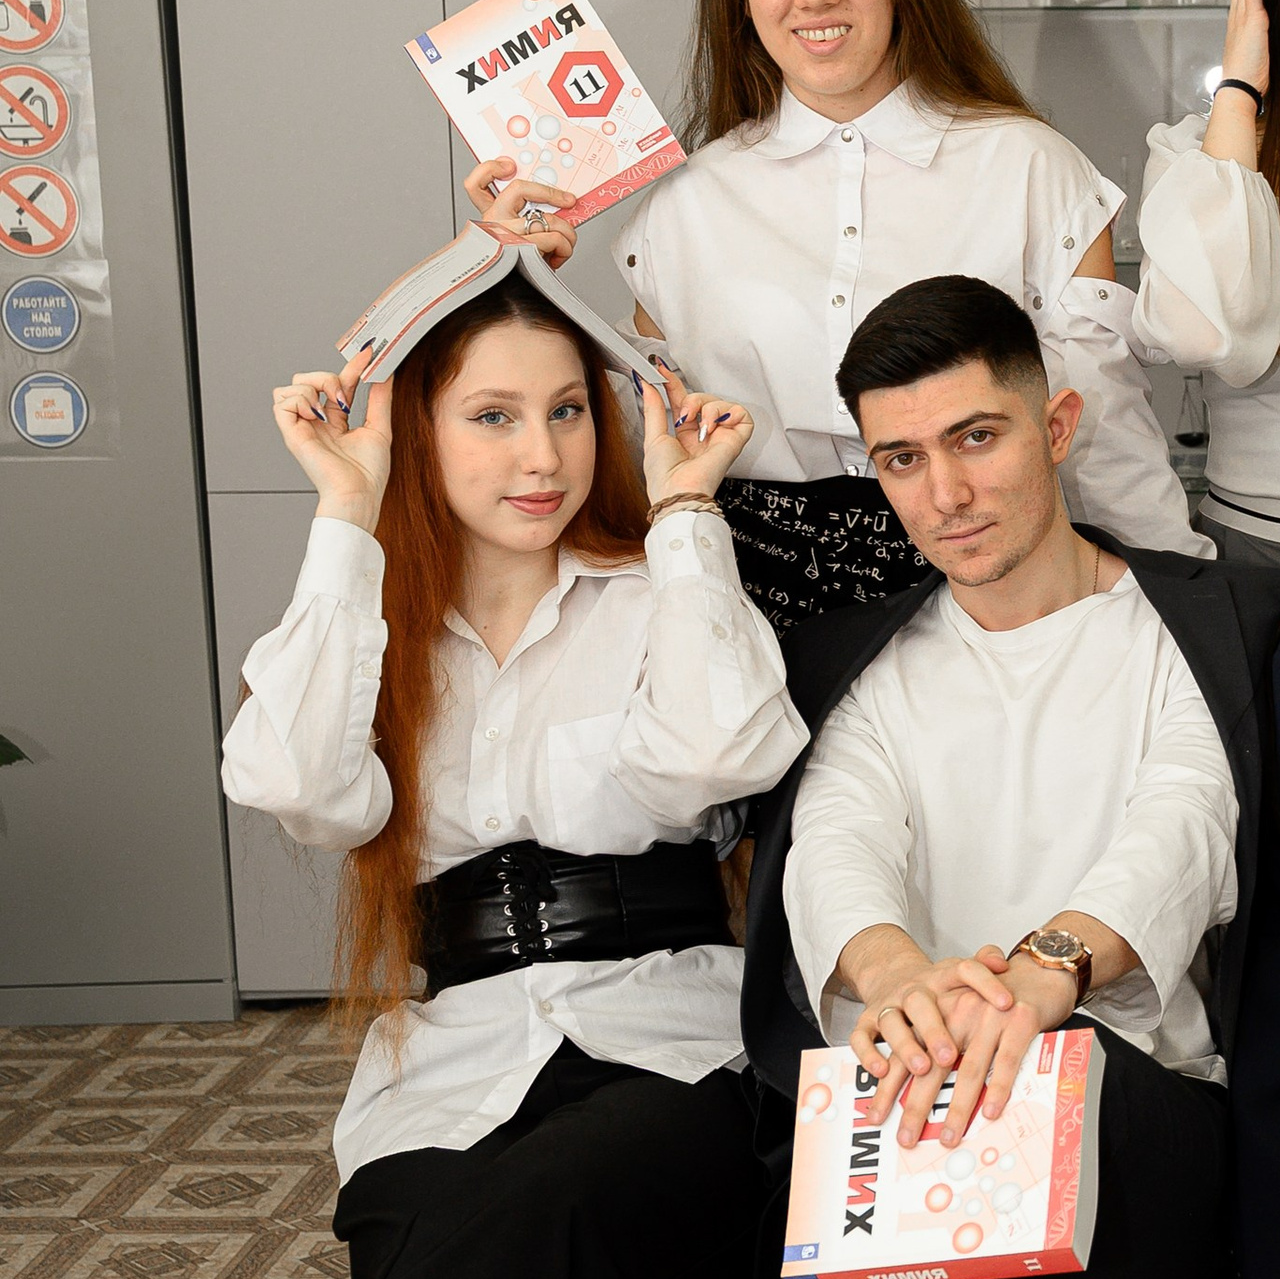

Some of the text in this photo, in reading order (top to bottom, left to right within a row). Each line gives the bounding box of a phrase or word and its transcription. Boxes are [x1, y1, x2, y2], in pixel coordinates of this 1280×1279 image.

[455, 3, 586, 94] ХИМИЯ
[569, 69, 605, 102] 11
[12, 295, 67, 309] РАБОТАЙТЕ
[31, 312, 52, 325] НАД
[23, 326, 62, 338] СТОЛОМ
[1023, 1257, 1043, 1272] 11
